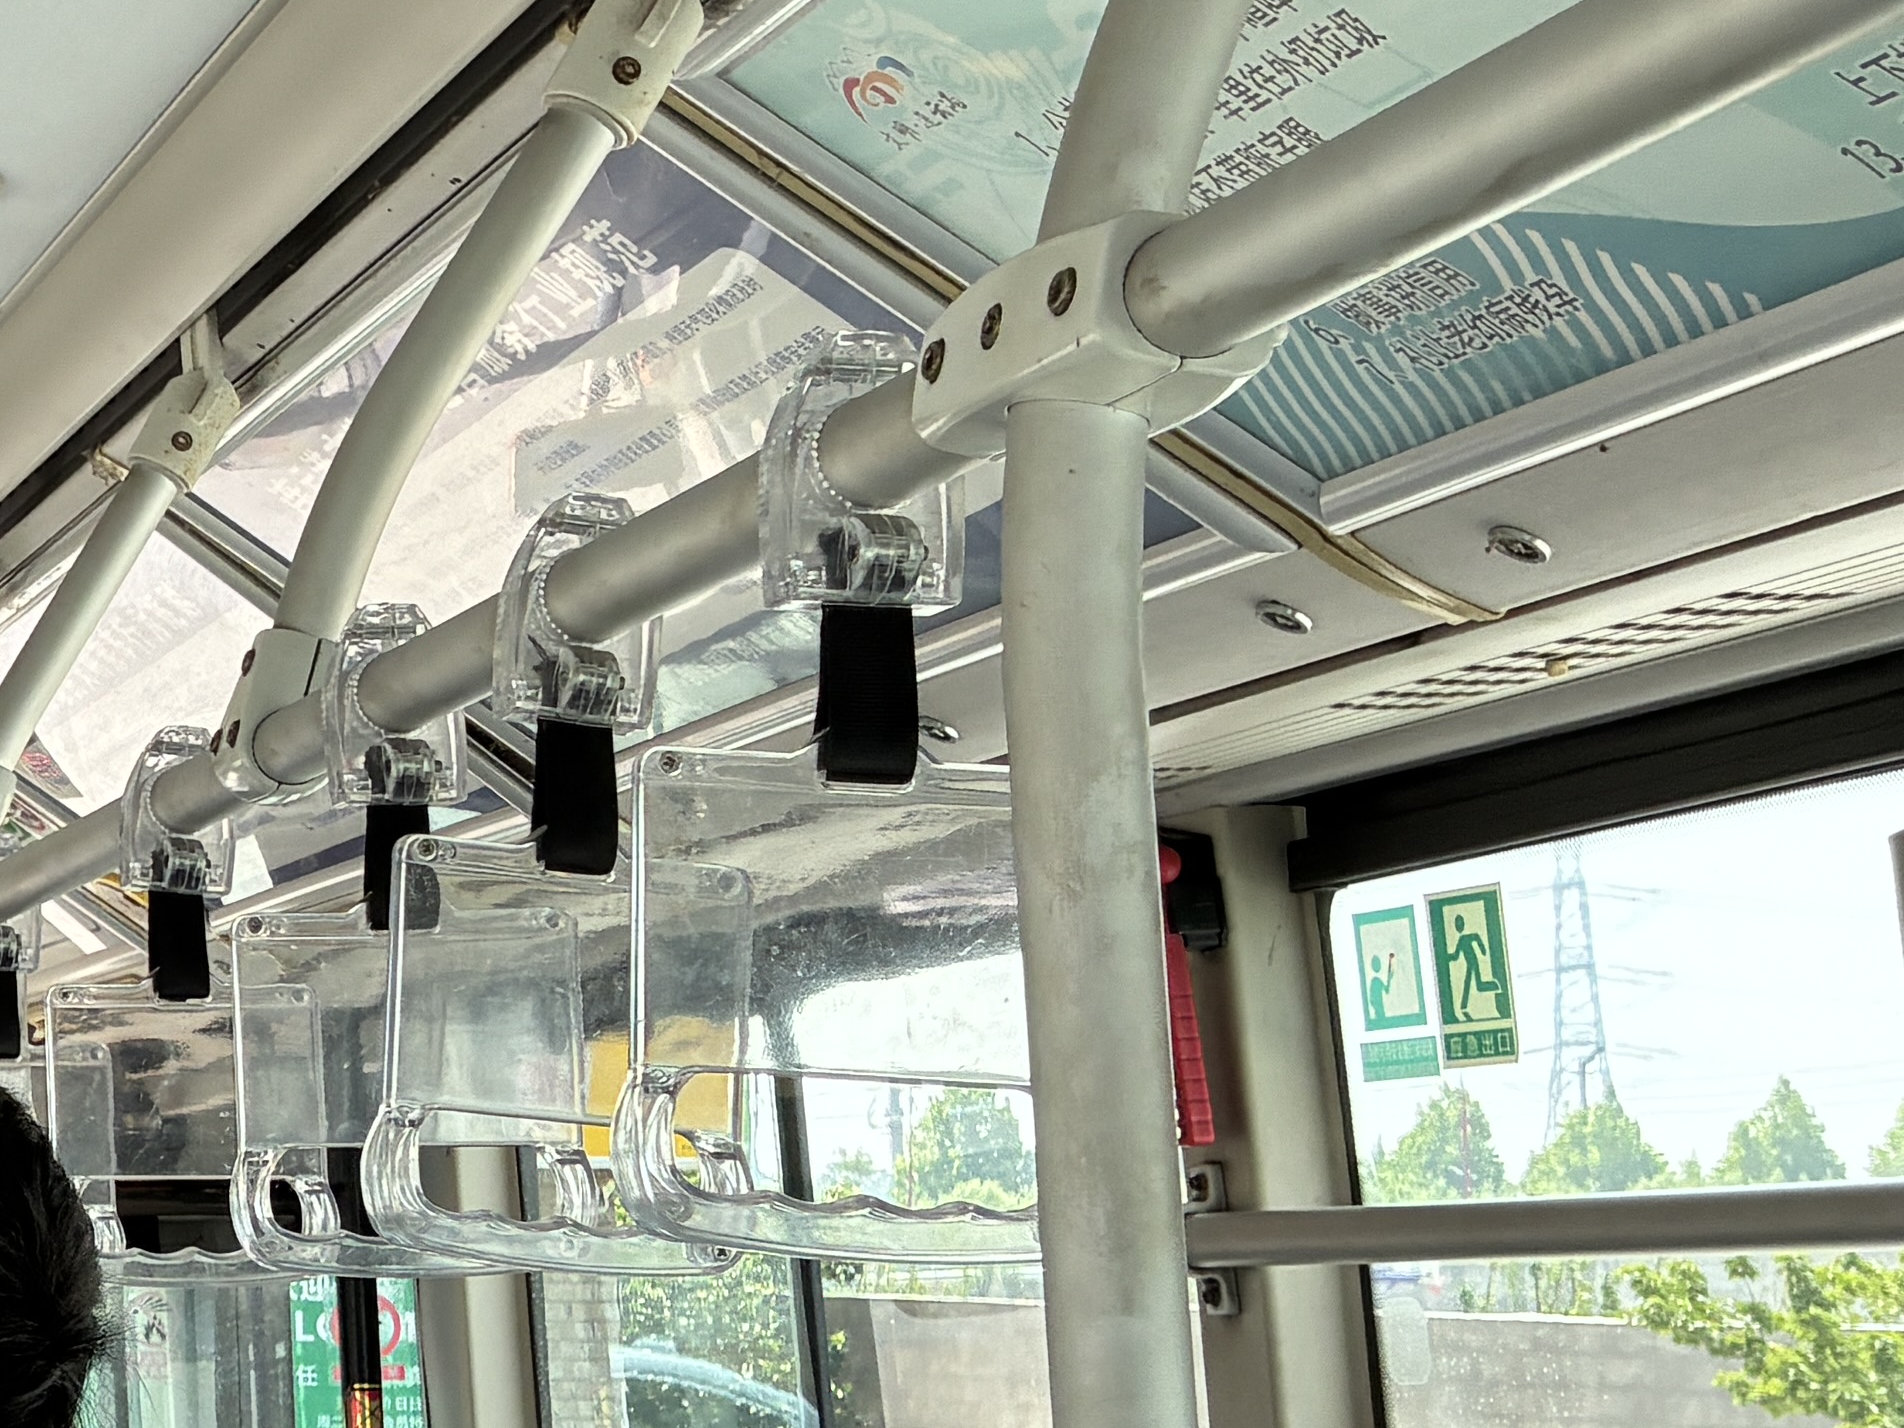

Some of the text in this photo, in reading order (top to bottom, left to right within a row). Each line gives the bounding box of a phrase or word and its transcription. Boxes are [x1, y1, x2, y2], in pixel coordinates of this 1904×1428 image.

[1355, 277, 1583, 386] 7、礼让老幼病残孕
